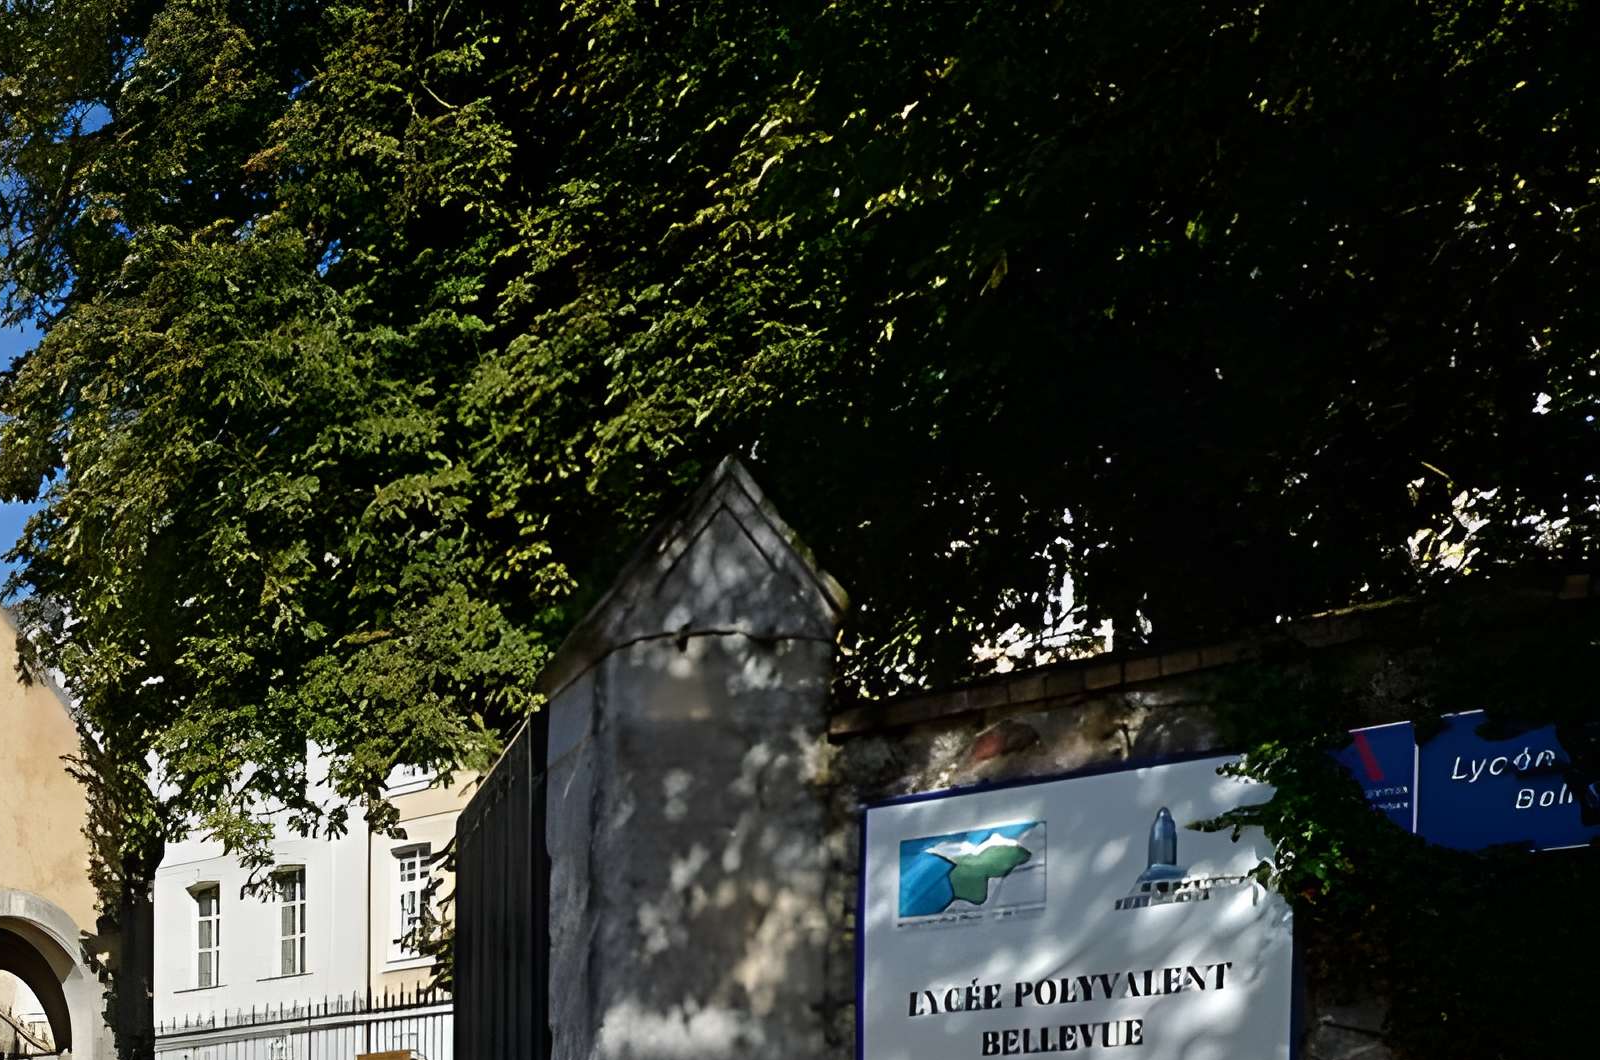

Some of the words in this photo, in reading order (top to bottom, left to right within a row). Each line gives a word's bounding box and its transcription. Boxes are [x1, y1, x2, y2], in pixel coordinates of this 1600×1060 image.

[909, 977, 1001, 1016] LYCÉE
[1015, 962, 1232, 1008] POLYVALENT
[982, 1019, 1143, 1056] BELLEVUE
